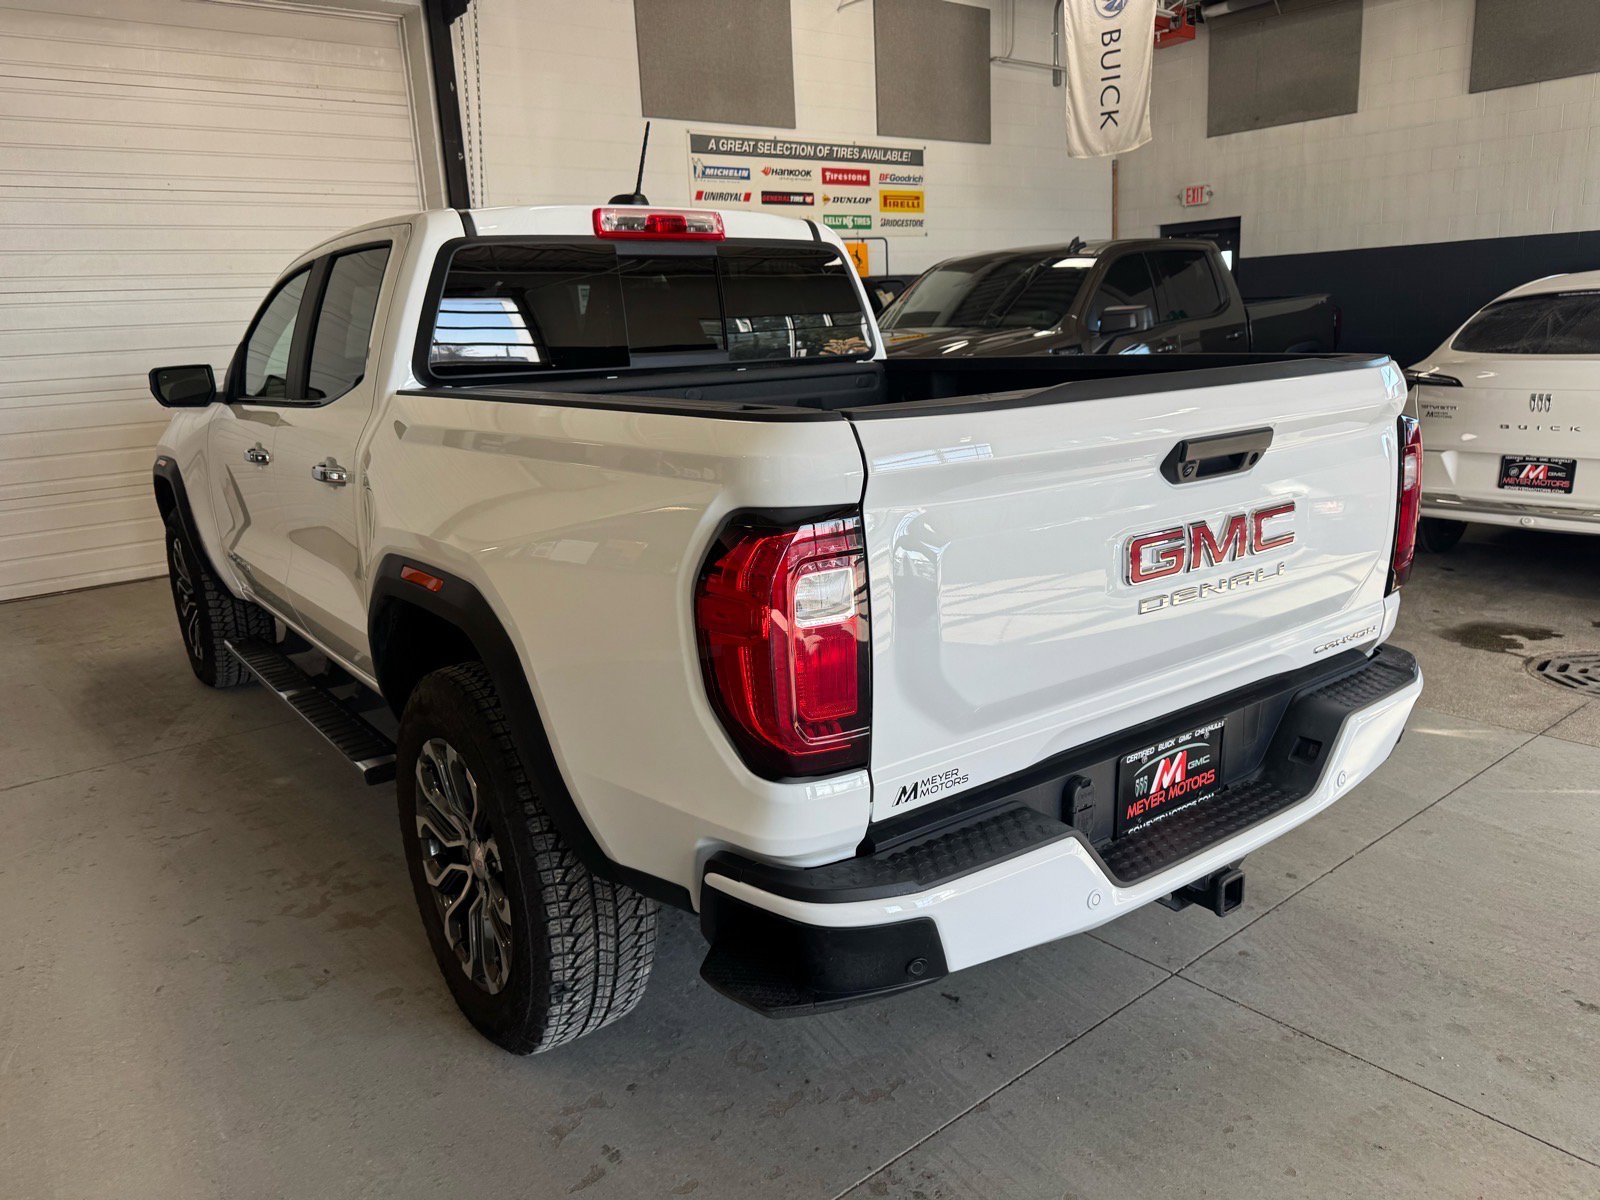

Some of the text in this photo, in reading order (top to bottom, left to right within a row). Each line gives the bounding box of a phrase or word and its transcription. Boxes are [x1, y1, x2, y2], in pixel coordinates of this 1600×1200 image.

[1100, 28, 1122, 130] BUICK
[708, 138, 912, 162] A GREAT SELECTION OF TIRES AVAILABLE!
[705, 168, 748, 178] MICHELIN
[825, 171, 867, 182] Firestone
[879, 173, 923, 183] BFGoodrich
[704, 191, 743, 202] UNIROYAL
[832, 196, 872, 204] DUNLOP
[883, 195, 921, 208] PIRELLI
[1186, 185, 1205, 204] EXIT
[824, 216, 871, 226] KELLY TIRES
[880, 218, 924, 228] BRIDGESTONE
[1500, 424, 1581, 432] BUICK
[1503, 477, 1570, 488] MEYER MOTORS
[1123, 500, 1296, 586] GMC
[1137, 561, 1286, 615] DENALI
[1126, 746, 1155, 762] CERTIFIED
[1157, 741, 1176, 752] BUICK
[1178, 732, 1192, 744] GMC
[1188, 754, 1210, 769] GMC
[920, 768, 959, 788] MEYER
[920, 774, 969, 798] MOTORS
[1127, 769, 1215, 820] MEYER MOTORS
